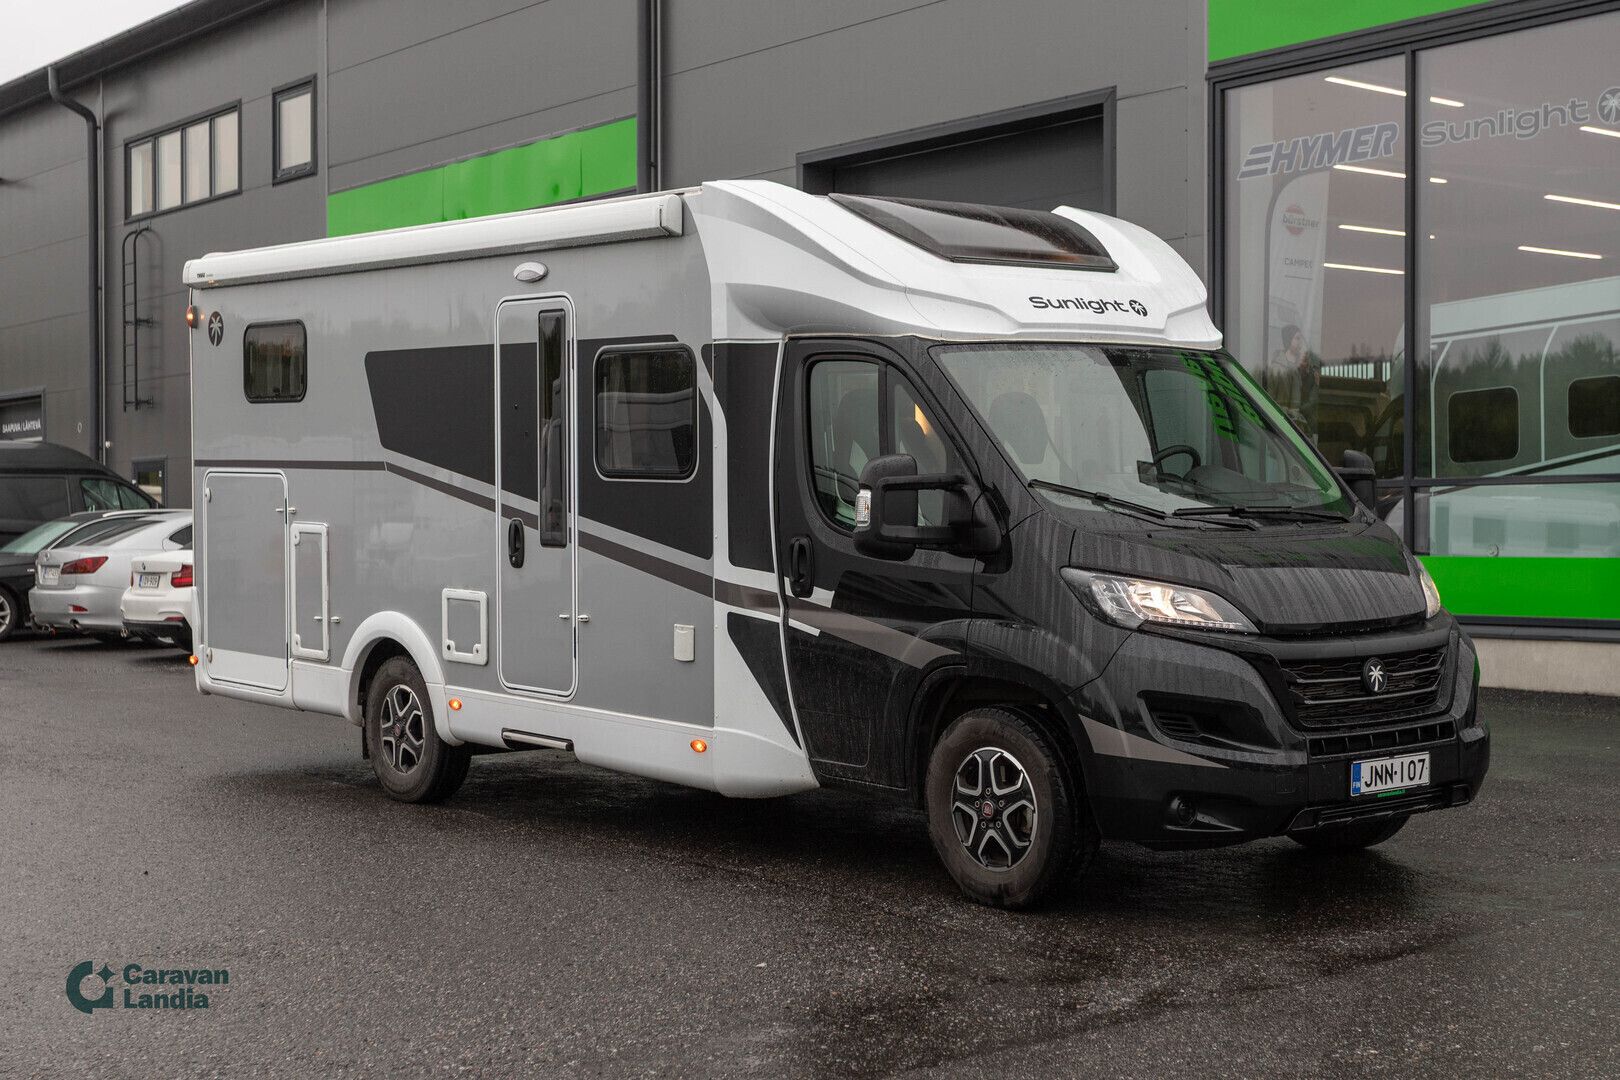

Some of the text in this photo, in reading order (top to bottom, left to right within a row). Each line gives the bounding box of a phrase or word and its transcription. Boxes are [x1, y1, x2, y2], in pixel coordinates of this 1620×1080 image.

[1421, 97, 1590, 147] Sunlight
[1269, 121, 1399, 175] HYMER
[1029, 296, 1130, 314] Sunlight
[1364, 758, 1426, 788] JNN-107
